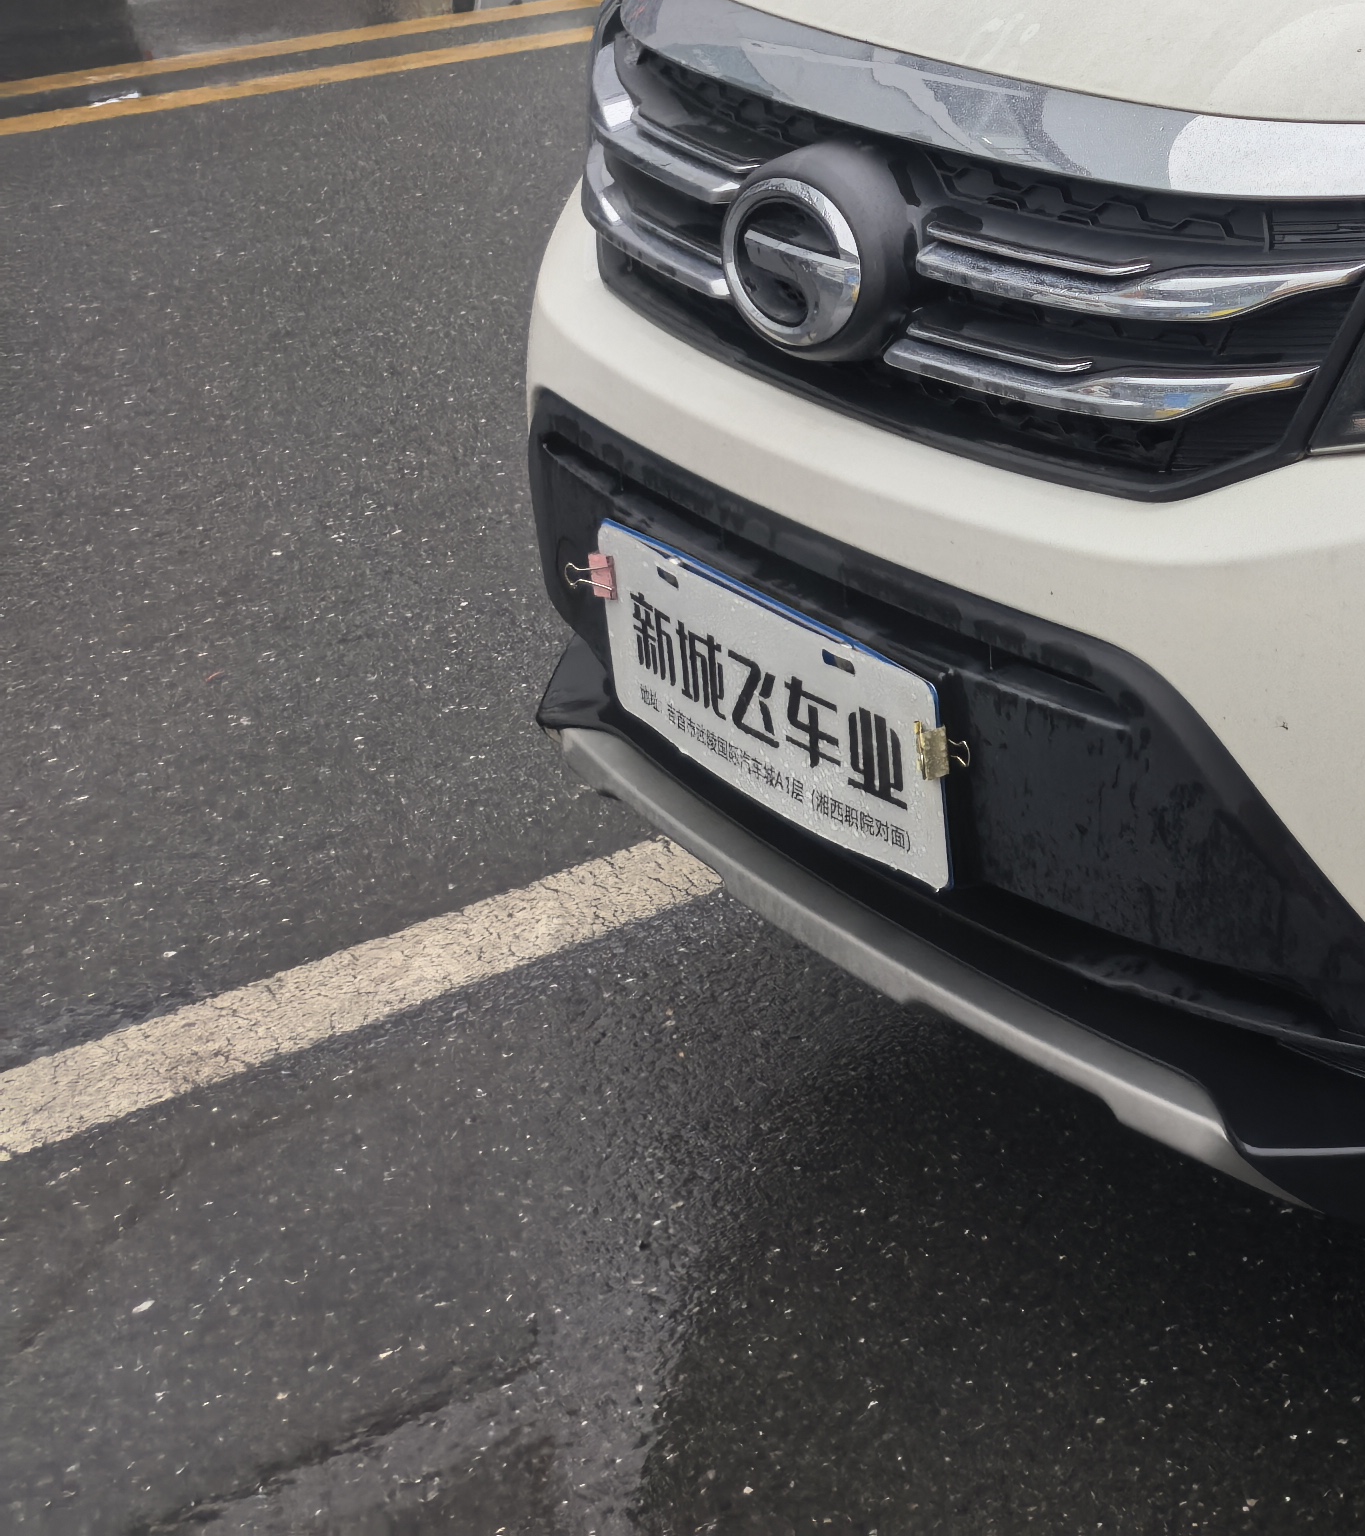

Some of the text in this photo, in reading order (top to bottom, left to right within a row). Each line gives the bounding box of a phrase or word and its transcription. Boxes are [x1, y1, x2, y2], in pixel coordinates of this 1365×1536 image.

[630, 591, 908, 811] 新城飞车业
